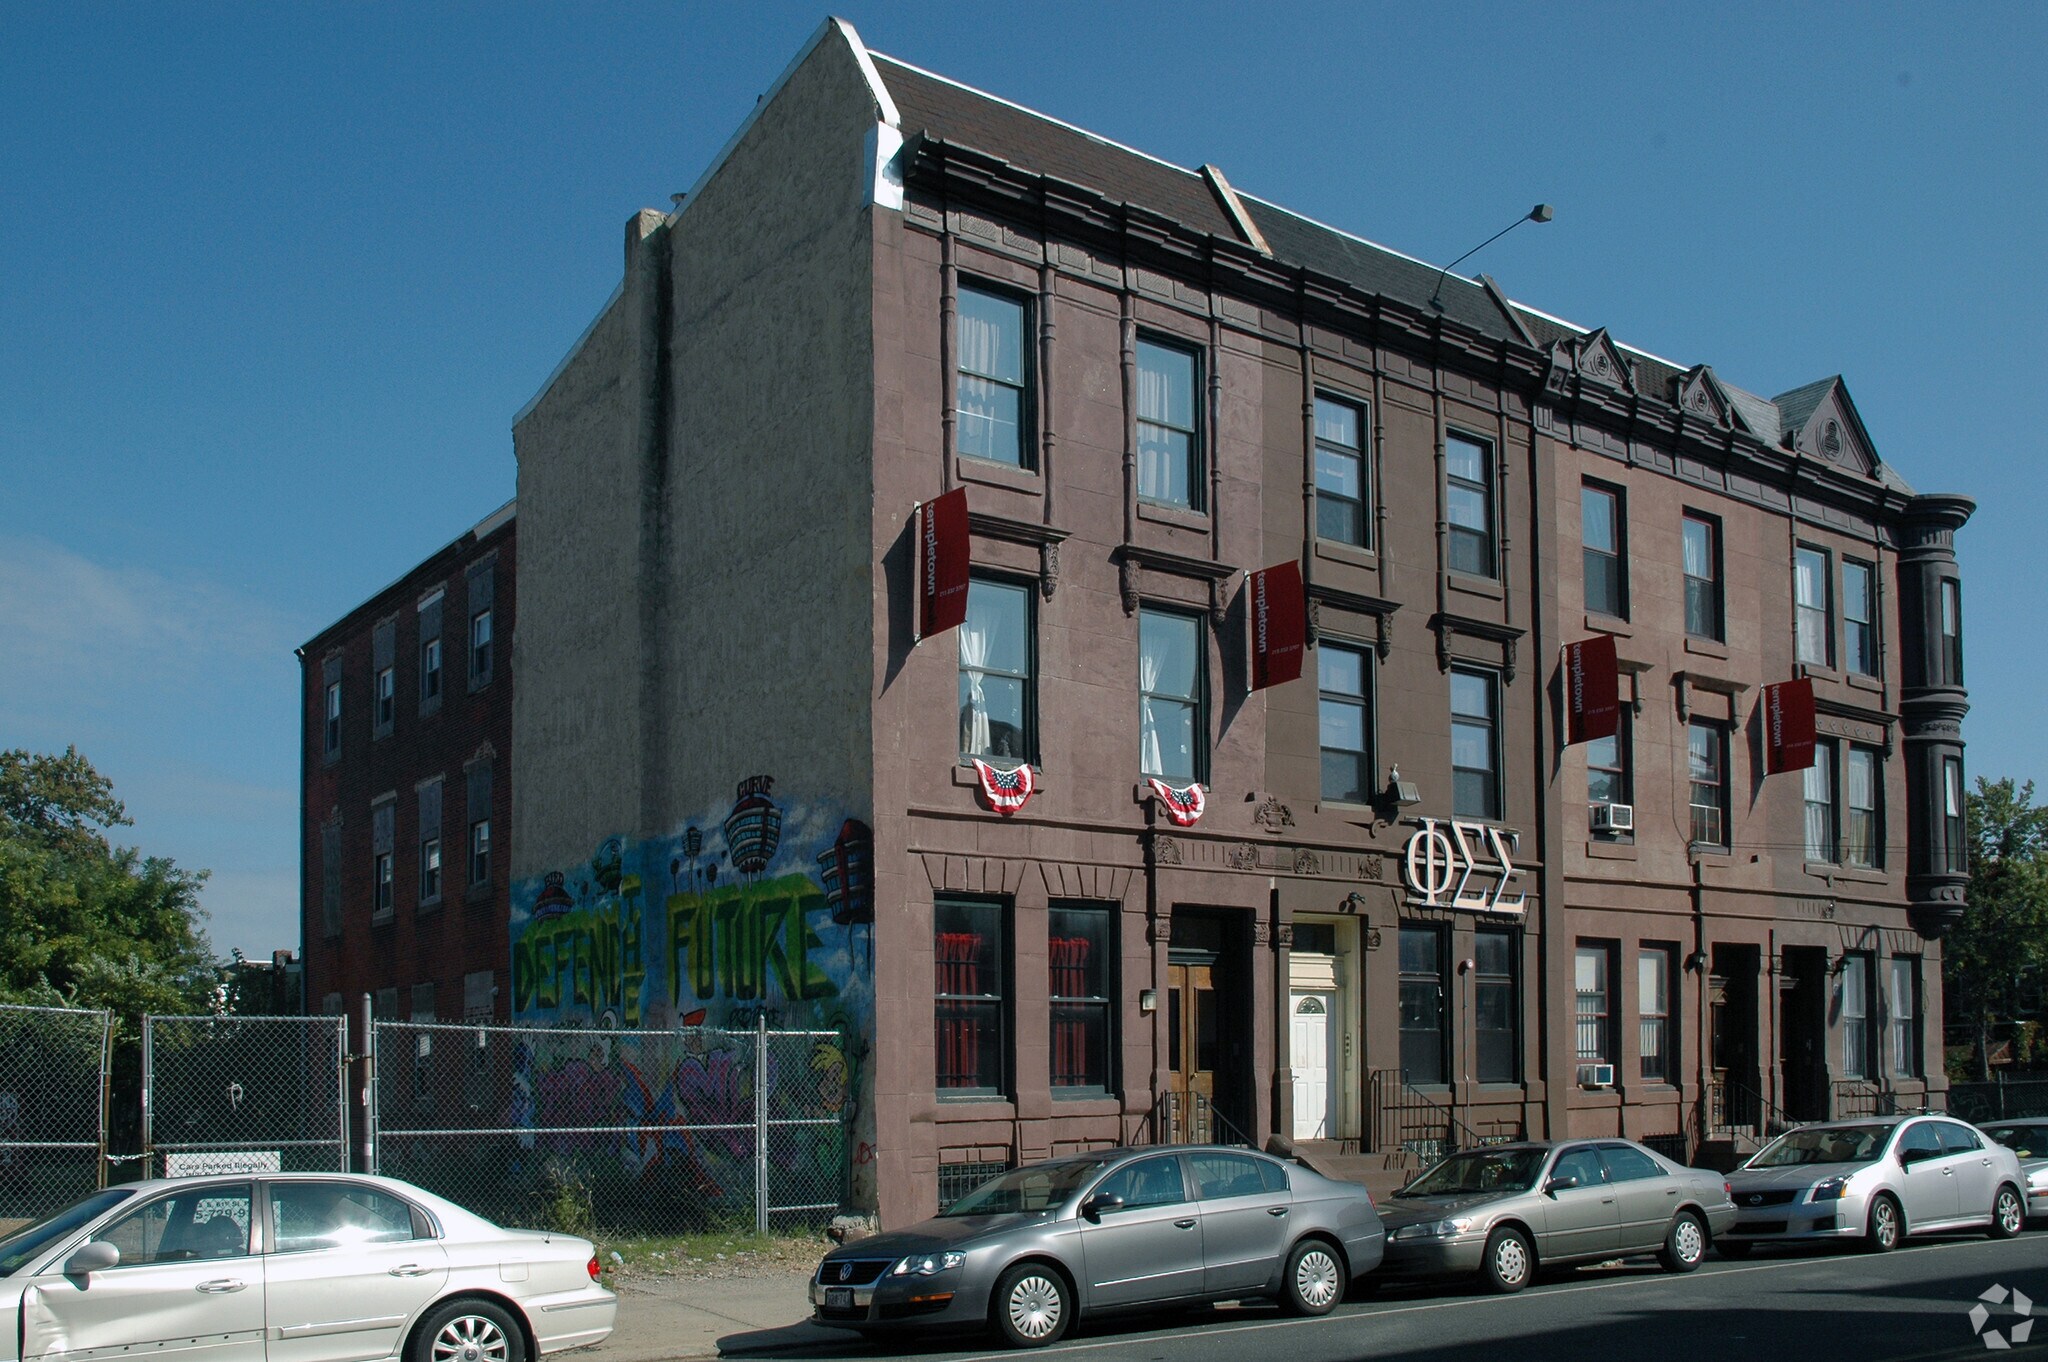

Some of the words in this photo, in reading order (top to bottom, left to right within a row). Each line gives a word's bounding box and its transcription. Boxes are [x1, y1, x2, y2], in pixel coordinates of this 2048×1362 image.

[924, 501, 939, 595] templetown
[1255, 571, 1270, 653] templetown
[1571, 642, 1585, 713] templetown
[1770, 684, 1784, 747] templetown
[513, 908, 622, 1013] DEFEND
[667, 873, 839, 1009] FUTURE
[179, 1163, 200, 1171] Cars
[202, 1162, 232, 1171] Parked
[234, 1161, 268, 1173] Illegally
